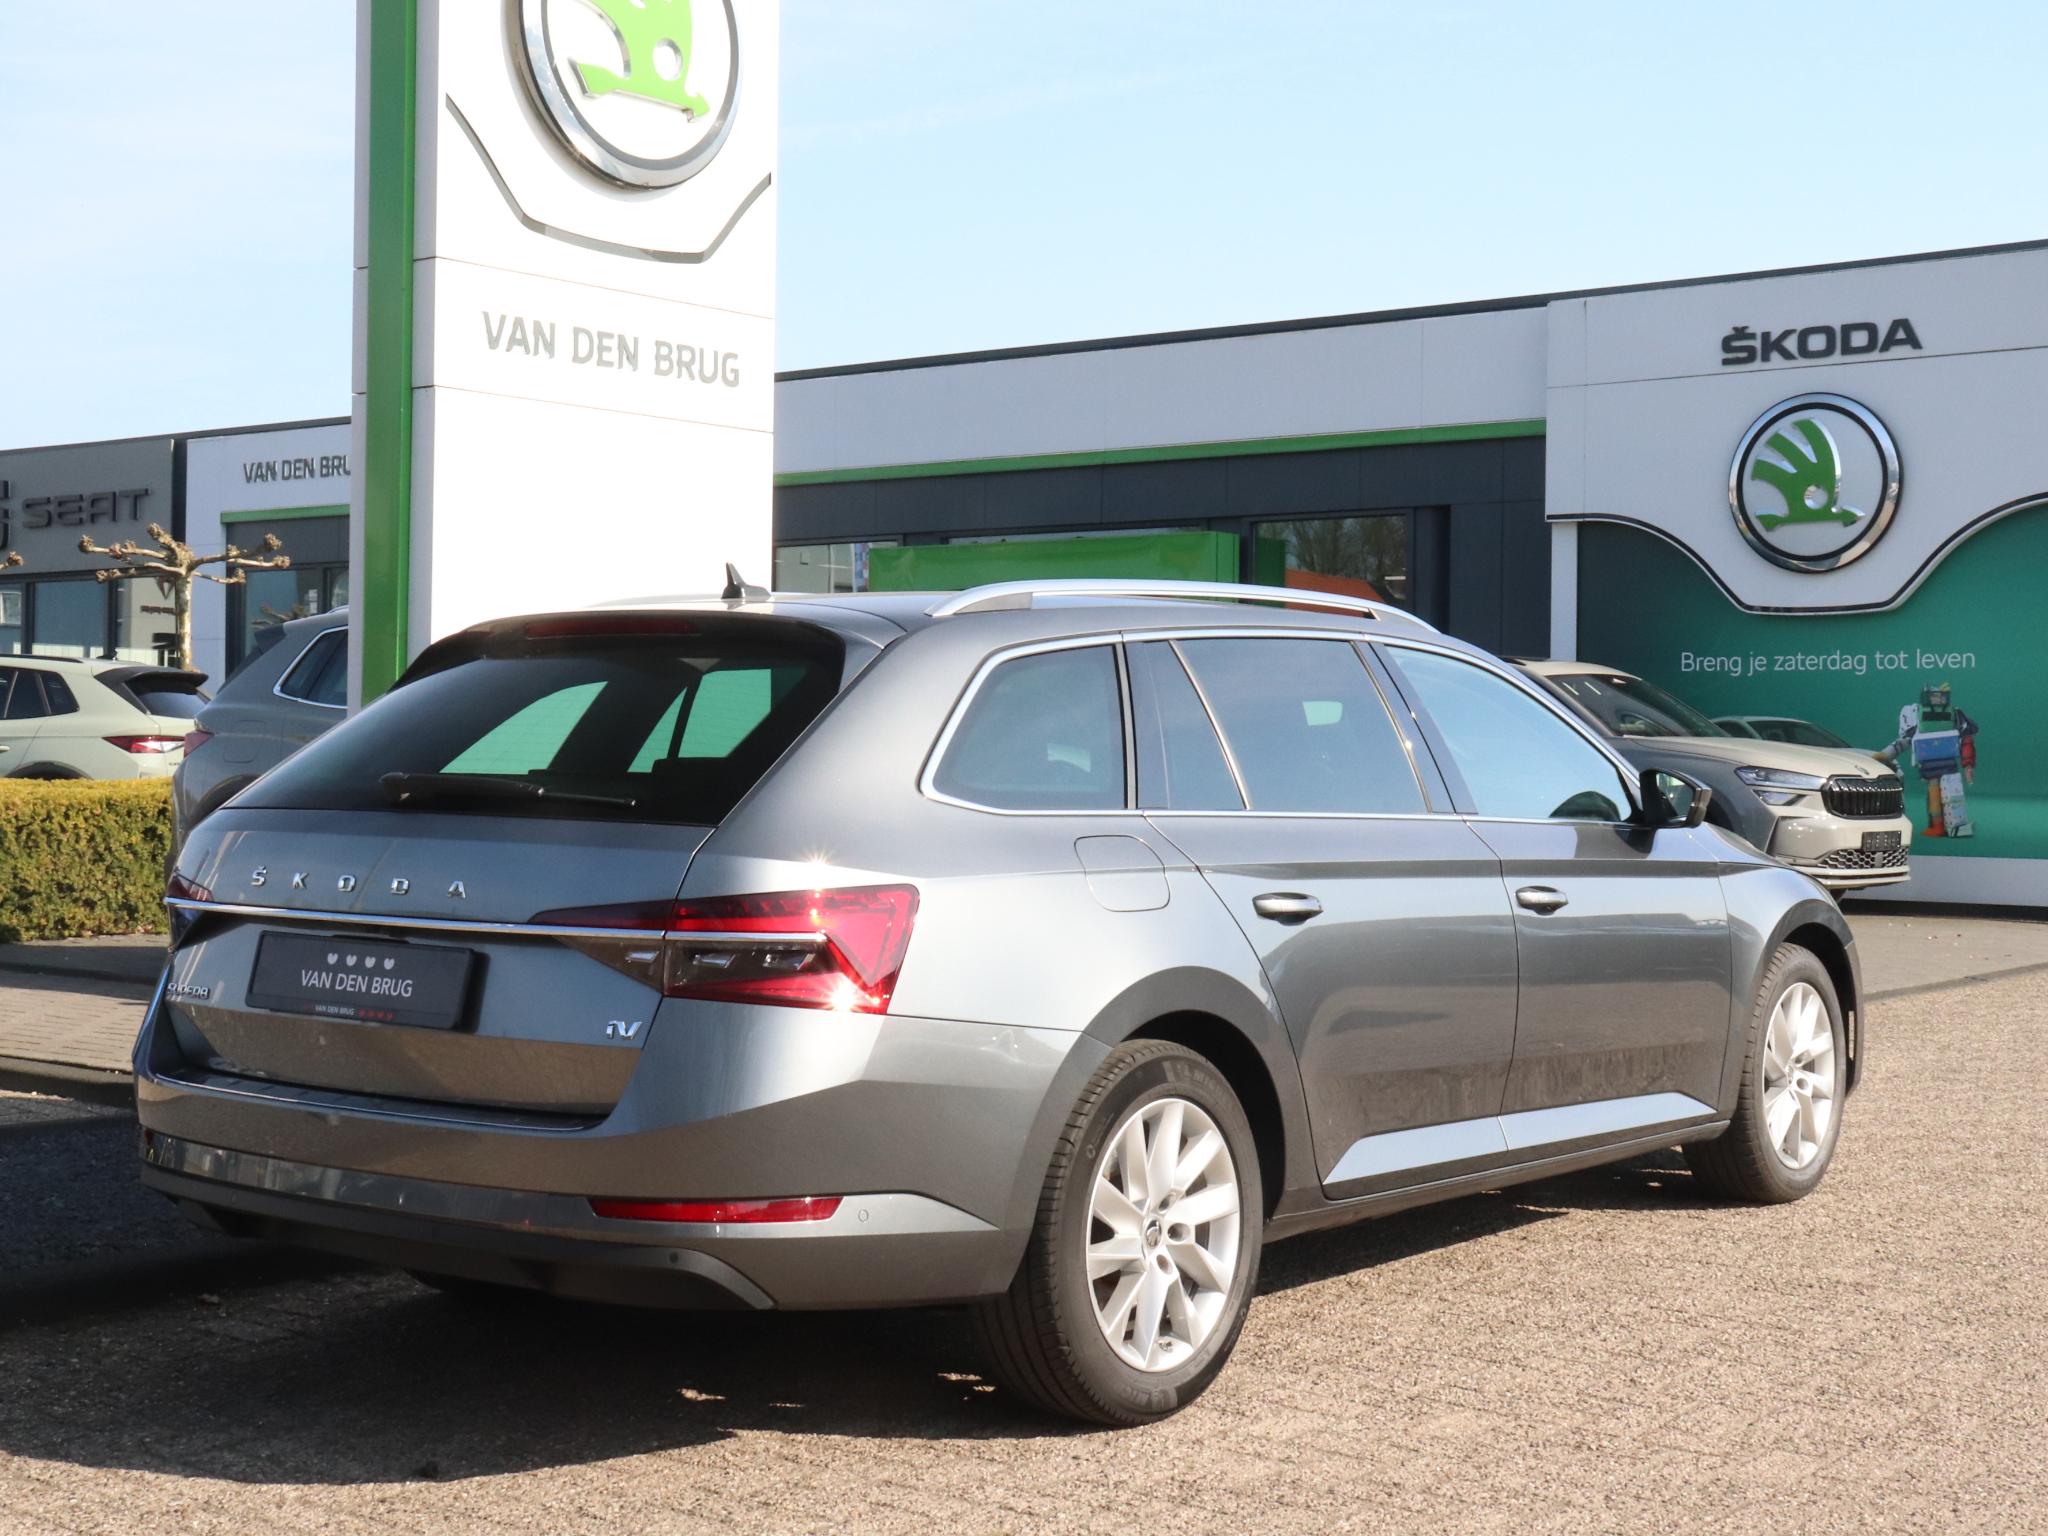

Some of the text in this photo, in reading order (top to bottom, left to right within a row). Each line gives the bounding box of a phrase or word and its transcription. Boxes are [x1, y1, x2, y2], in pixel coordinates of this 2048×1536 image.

[482, 311, 740, 388] VAN DEN BRUG
[1721, 318, 1923, 366] ŠKODA
[243, 455, 351, 483] VAN DEN BRU
[22, 488, 149, 528] SEAT
[1680, 649, 1976, 676] Breng je zaterdag tot leven
[251, 865, 467, 898] ŠKODA
[301, 969, 413, 997] VAN DEN BRUG
